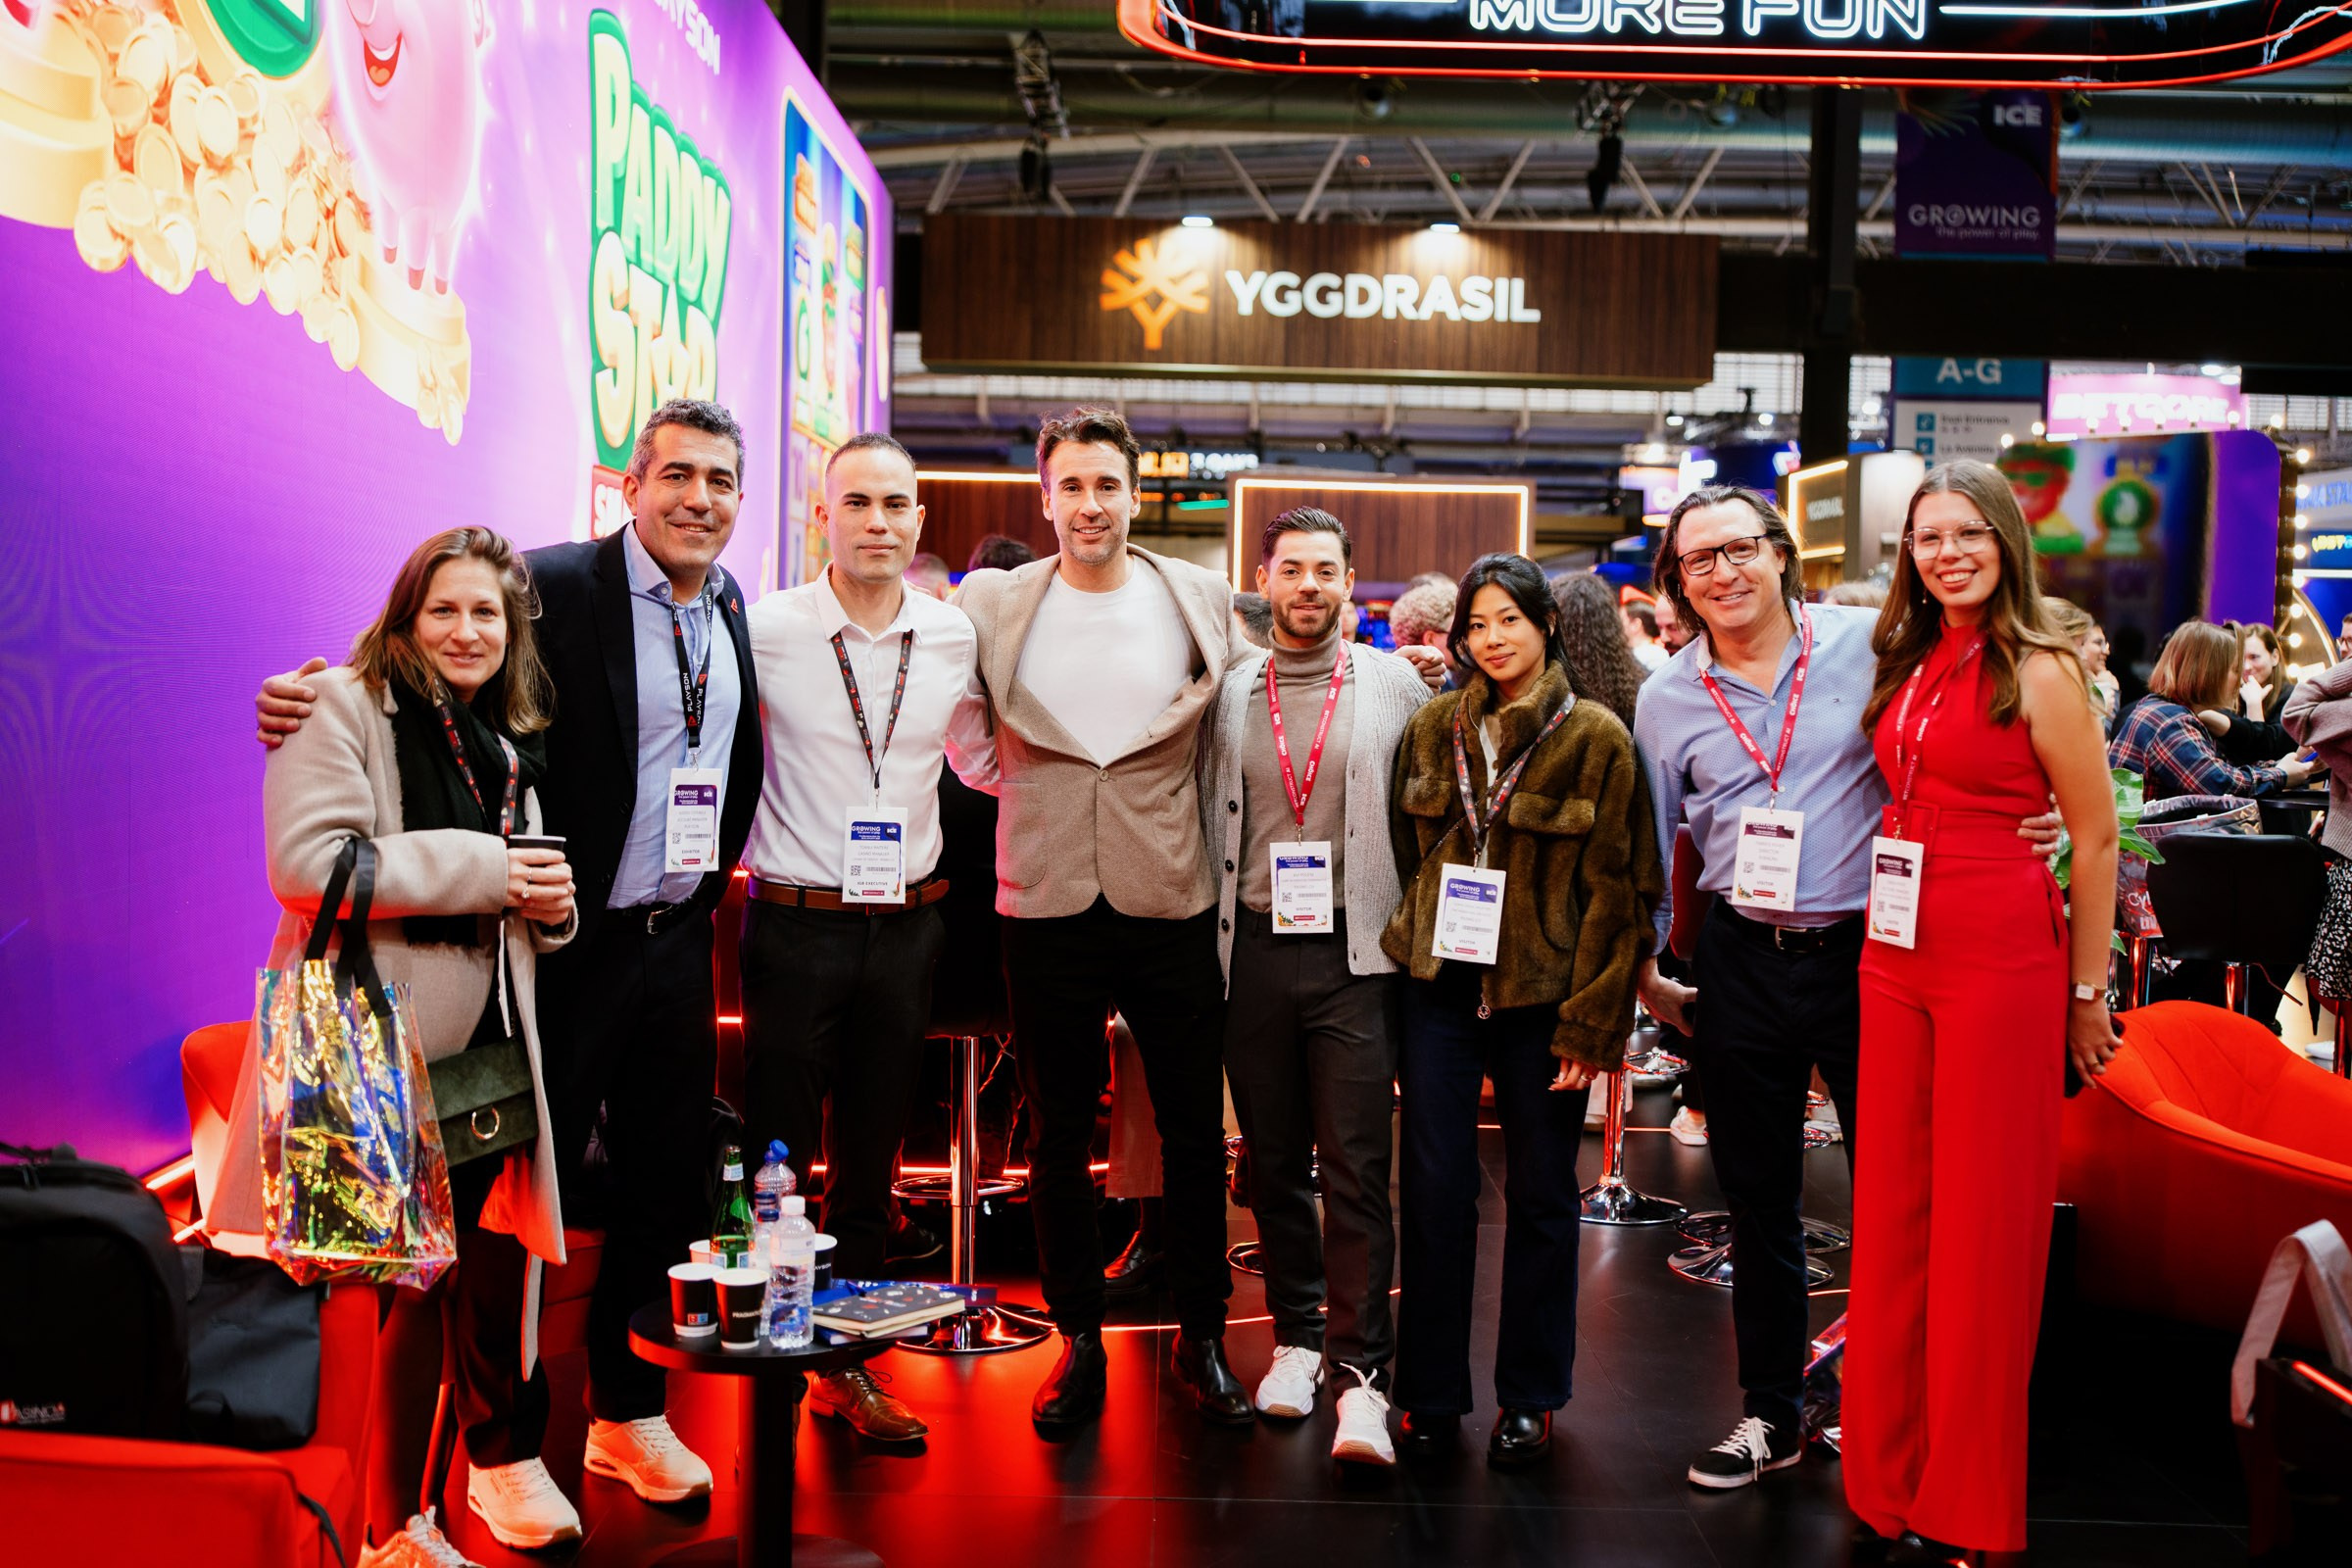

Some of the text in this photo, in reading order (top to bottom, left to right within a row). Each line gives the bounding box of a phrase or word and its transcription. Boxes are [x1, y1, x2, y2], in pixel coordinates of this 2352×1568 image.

[654, 0, 720, 75] YSON
[1469, 0, 1926, 41] MORE FUN
[1993, 104, 2042, 127] ICE
[592, 32, 731, 321] PADDY
[1908, 204, 2041, 227] GROWING
[1224, 270, 1542, 323] YGGDRASIL
[593, 230, 716, 449] STOP
[1936, 357, 2002, 385] A-G
[683, 673, 693, 711] PLAYSON
[1796, 668, 1805, 681] ICE
[1317, 710, 1329, 743] BETCONSTRUCT
[1449, 883, 1481, 893] GROWING
